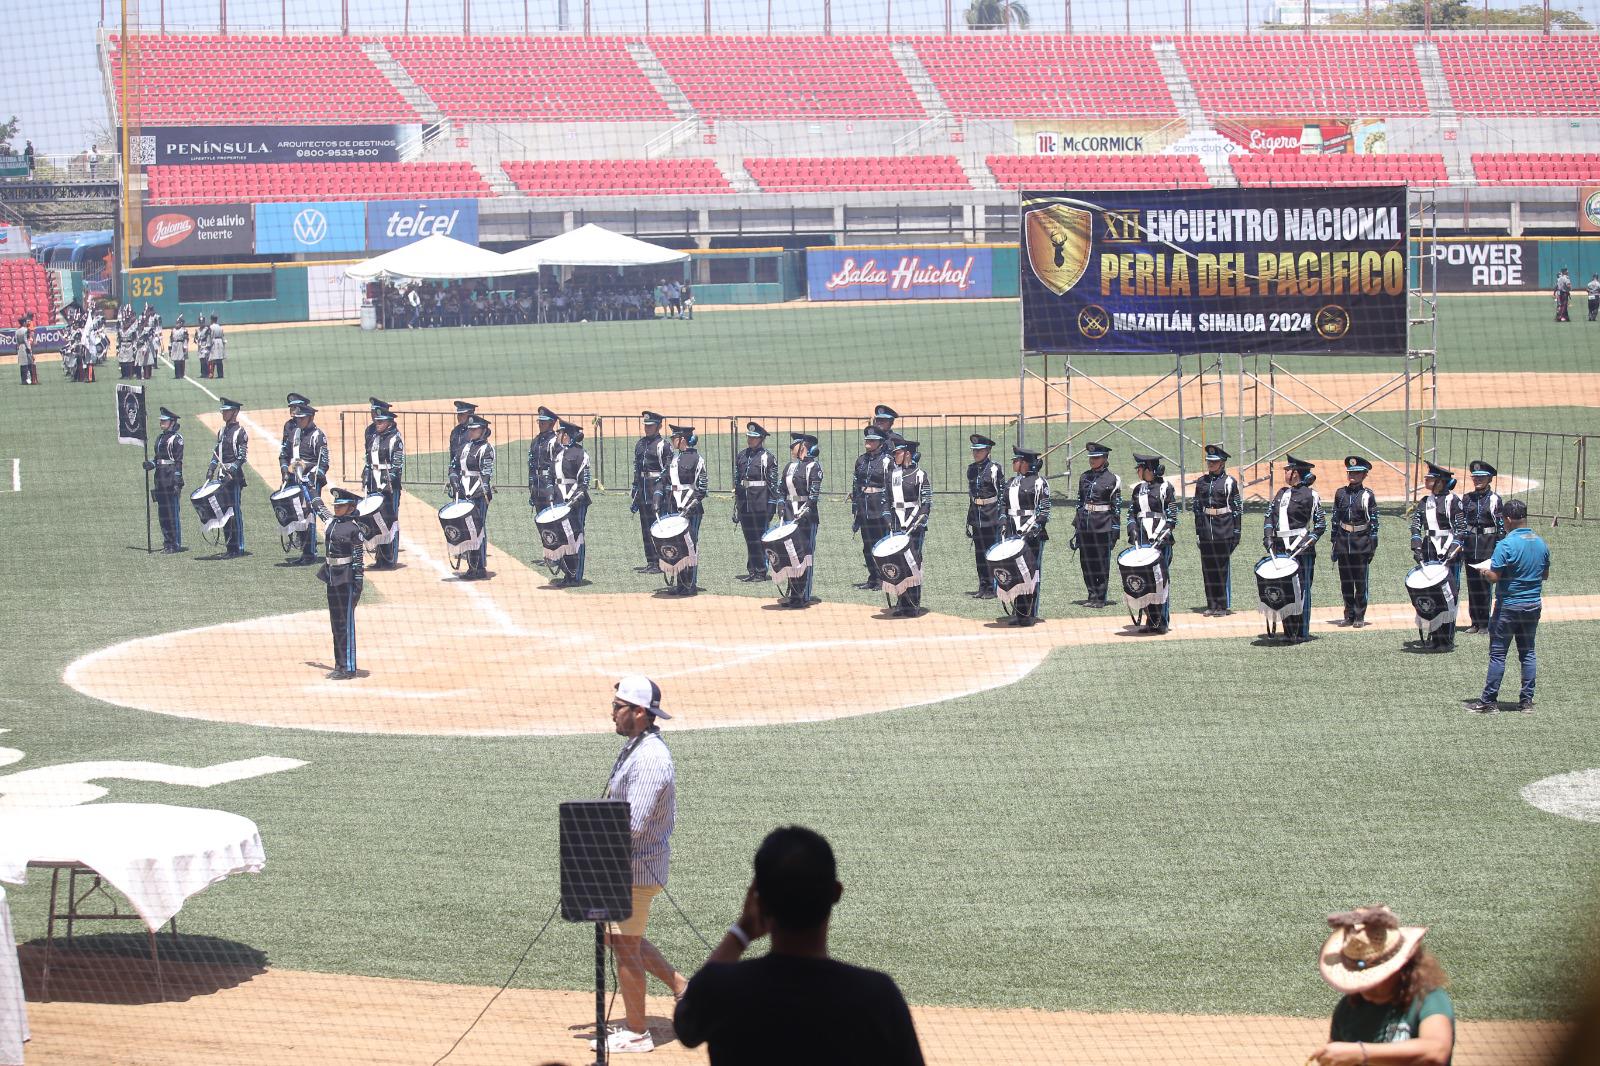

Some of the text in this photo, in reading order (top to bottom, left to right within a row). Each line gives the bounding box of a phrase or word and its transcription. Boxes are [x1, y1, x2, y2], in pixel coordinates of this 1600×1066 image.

[166, 140, 268, 154] PENÍNSULA
[277, 140, 337, 148] ARQUITECTOS
[353, 139, 396, 147] DESTINOS
[1063, 136, 1144, 152] McCORMICK
[1201, 143, 1222, 152] club
[1250, 128, 1301, 152] Ligero
[296, 148, 378, 158] 0800-9533-800
[197, 214, 245, 227] Qué alivio
[386, 207, 459, 237] telcel
[1101, 209, 1142, 243] XII
[1146, 208, 1279, 243] ENCUENTRO
[1284, 206, 1402, 242] NACIONAL
[197, 229, 233, 240] tenerte
[1430, 244, 1522, 265] POWER
[827, 256, 975, 289] Salsa Huichol
[1100, 251, 1404, 297] PERLA DEL PACIFICO
[1472, 265, 1523, 286] ADE
[132, 276, 164, 297] 325
[1113, 309, 1312, 333] MAZATLÁN, SINALOA 2024
[35, 332, 60, 343] ARCO
